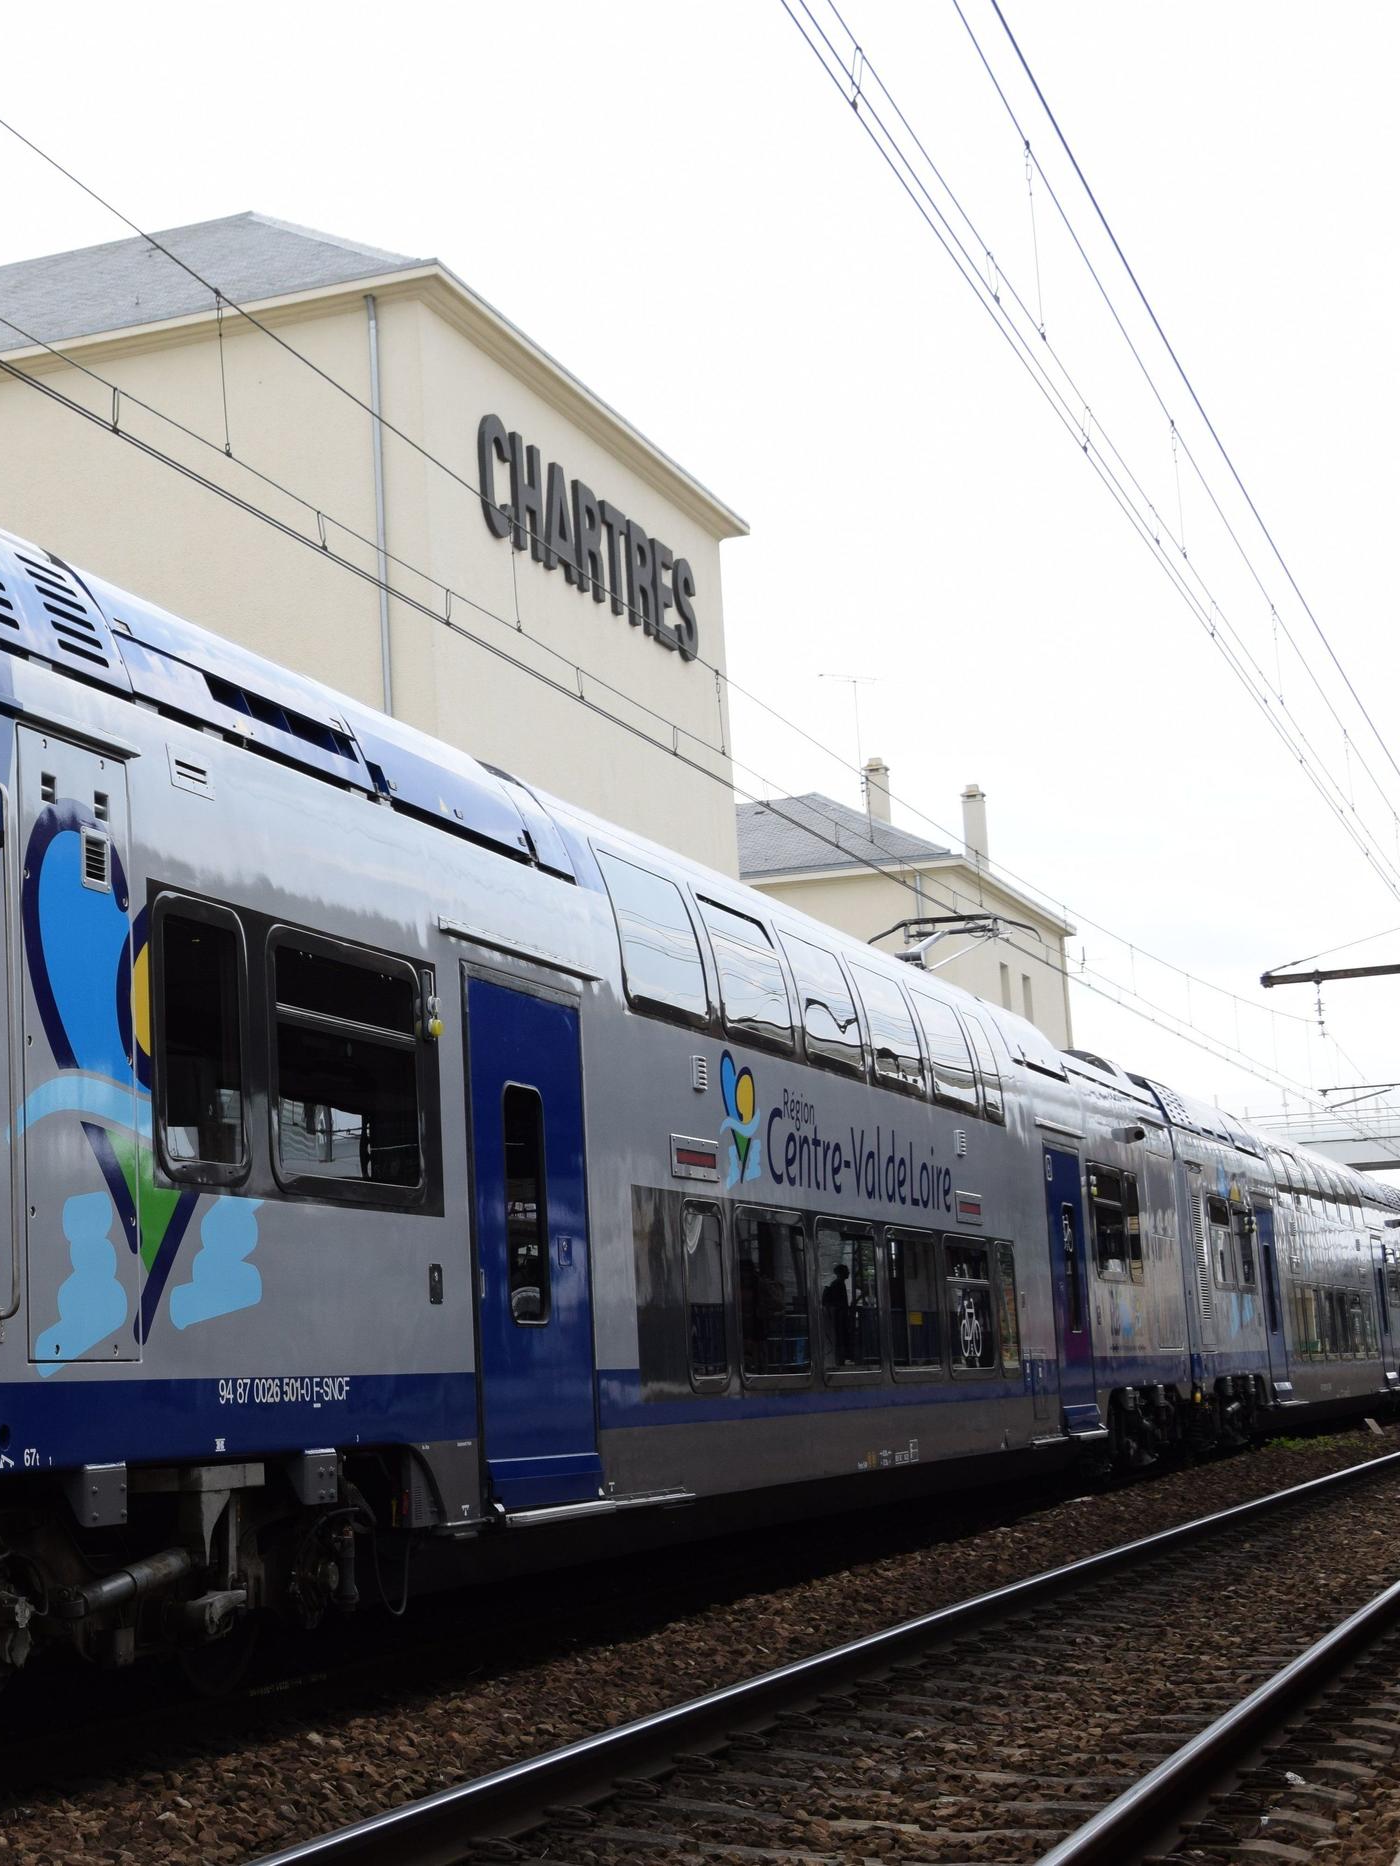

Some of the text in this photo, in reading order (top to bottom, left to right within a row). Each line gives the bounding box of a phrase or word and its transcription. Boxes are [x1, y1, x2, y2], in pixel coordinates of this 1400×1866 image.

[477, 413, 698, 662] CHARTRES
[783, 1088, 815, 1131] Région
[909, 1141, 951, 1212] Loire
[219, 1377, 350, 1404] 94 87 0026 501-0 F-SNCF
[24, 1447, 40, 1467] 67t
